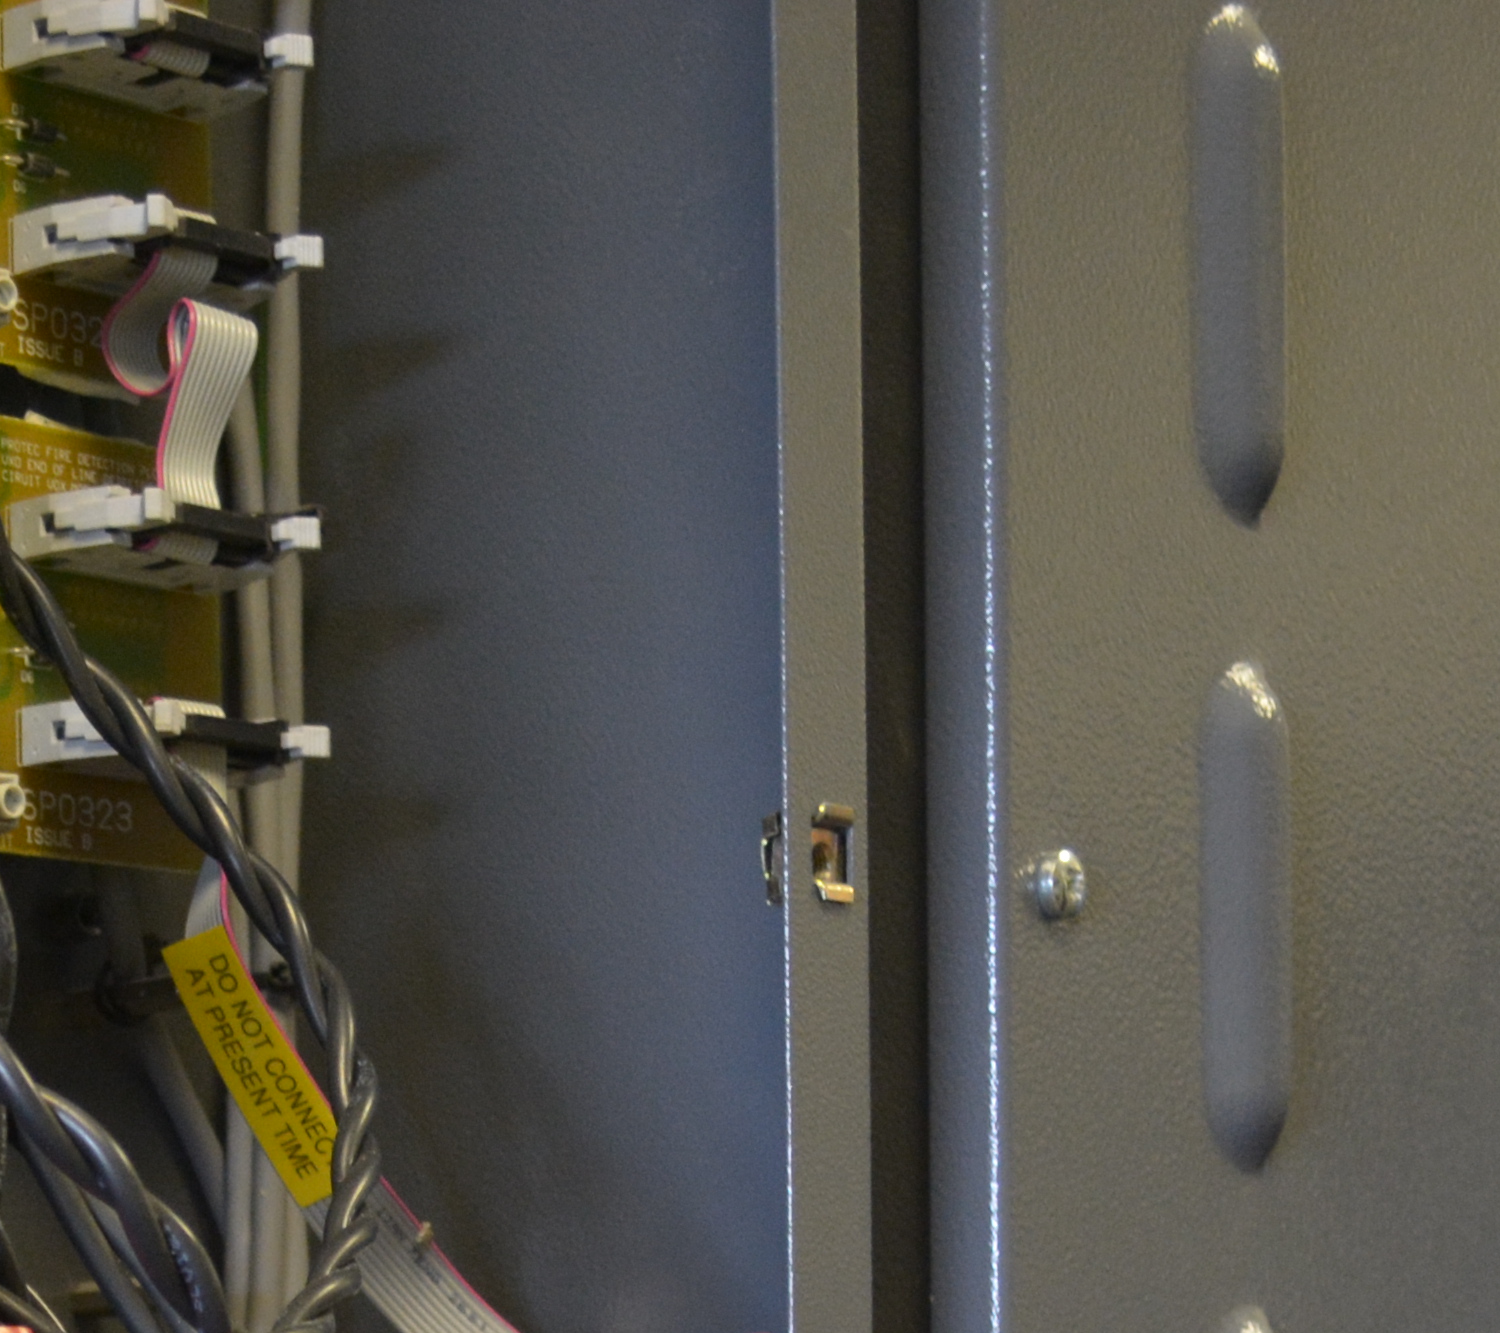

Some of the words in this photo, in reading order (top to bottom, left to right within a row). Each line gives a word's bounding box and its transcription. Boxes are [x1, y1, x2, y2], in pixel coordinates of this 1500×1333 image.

[18, 335, 63, 363] ISSUE
[23, 788, 134, 833] SP0323
[26, 826, 73, 847] ISSUE
[209, 954, 238, 993] DO
[232, 1001, 273, 1049] NOT
[185, 968, 215, 999] AT
[205, 1006, 281, 1117] PRESENT
[274, 1123, 318, 1180] TIME
